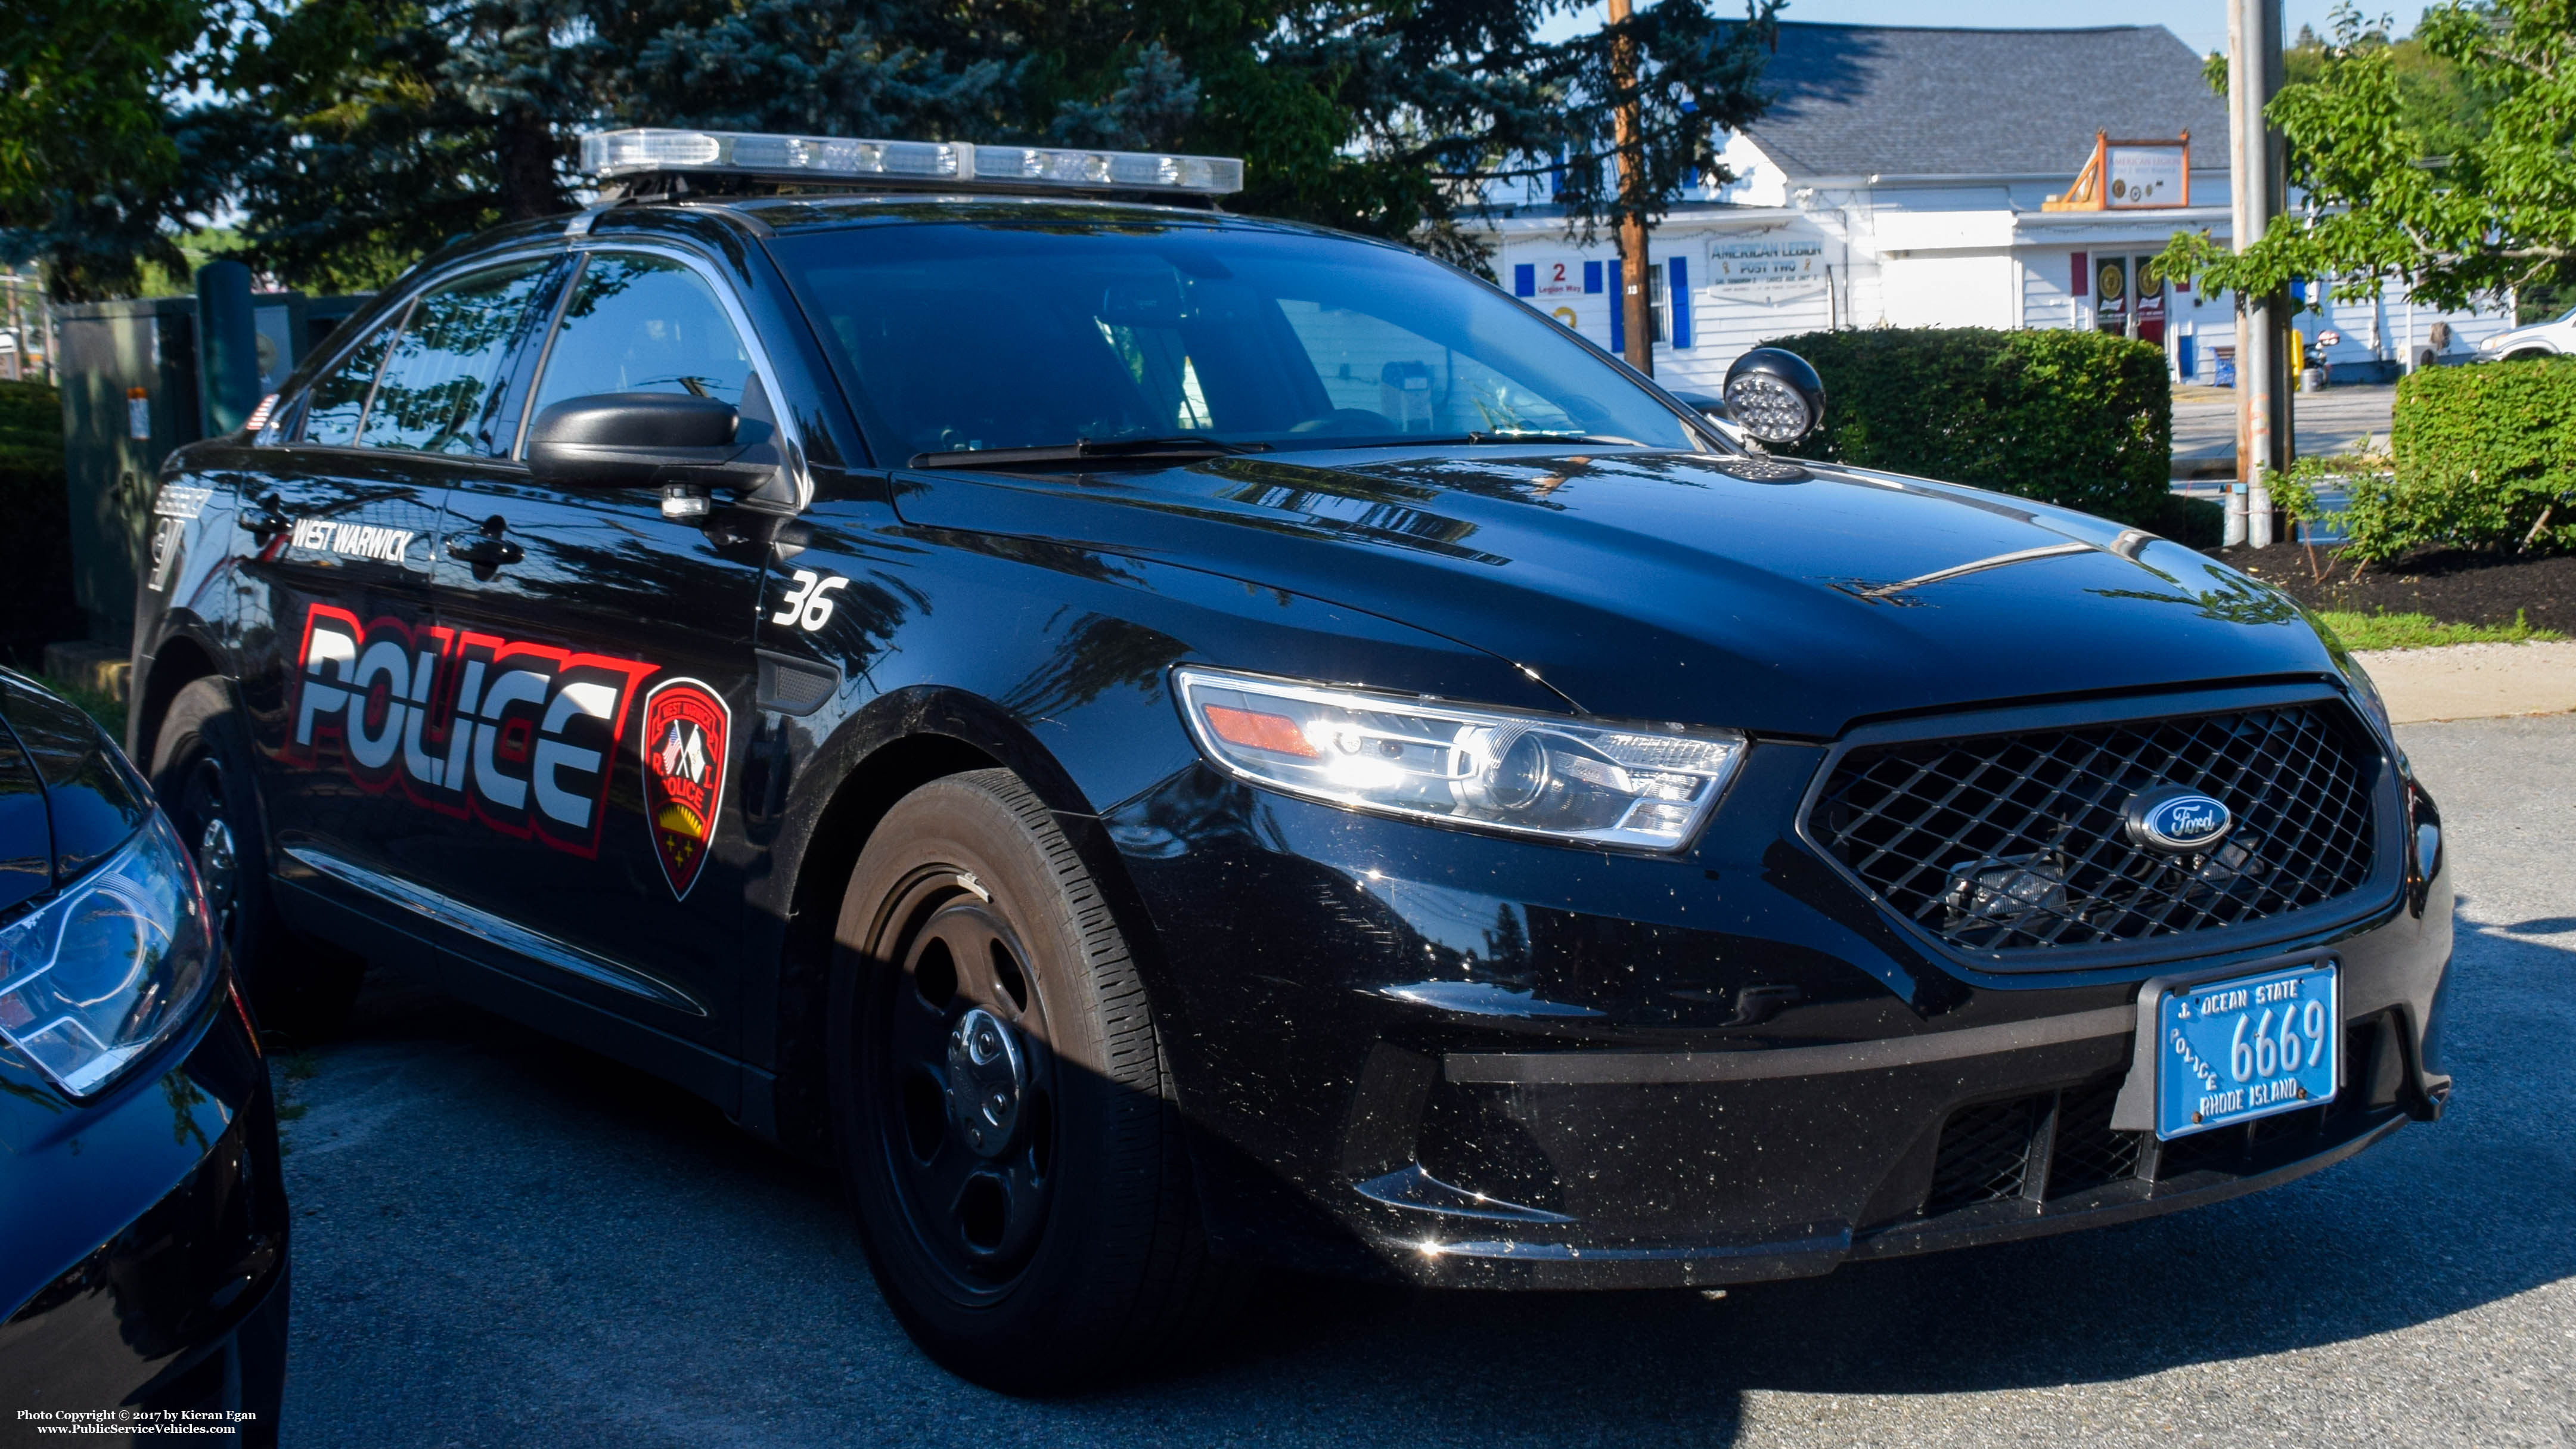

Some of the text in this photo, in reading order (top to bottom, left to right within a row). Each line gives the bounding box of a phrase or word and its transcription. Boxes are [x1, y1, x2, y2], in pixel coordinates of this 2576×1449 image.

[1712, 241, 1821, 259] AMERICAN LEGION
[1553, 263, 1566, 281] 2
[1740, 260, 1796, 274] POST TWO
[1538, 286, 1563, 294] Legion
[1627, 285, 1638, 294] 13
[291, 519, 414, 561] WEST WARWICK
[772, 570, 849, 631] 36
[663, 703, 681, 717] WEST
[296, 628, 617, 828] POLICE
[2172, 805, 2215, 836] Ford
[2202, 980, 2298, 1015] OCEAN STATE
[2232, 1000, 2324, 1082] 6669
[2170, 1028, 2217, 1091] POLICE
[2200, 1078, 2297, 1116] RHODE ISLAND
